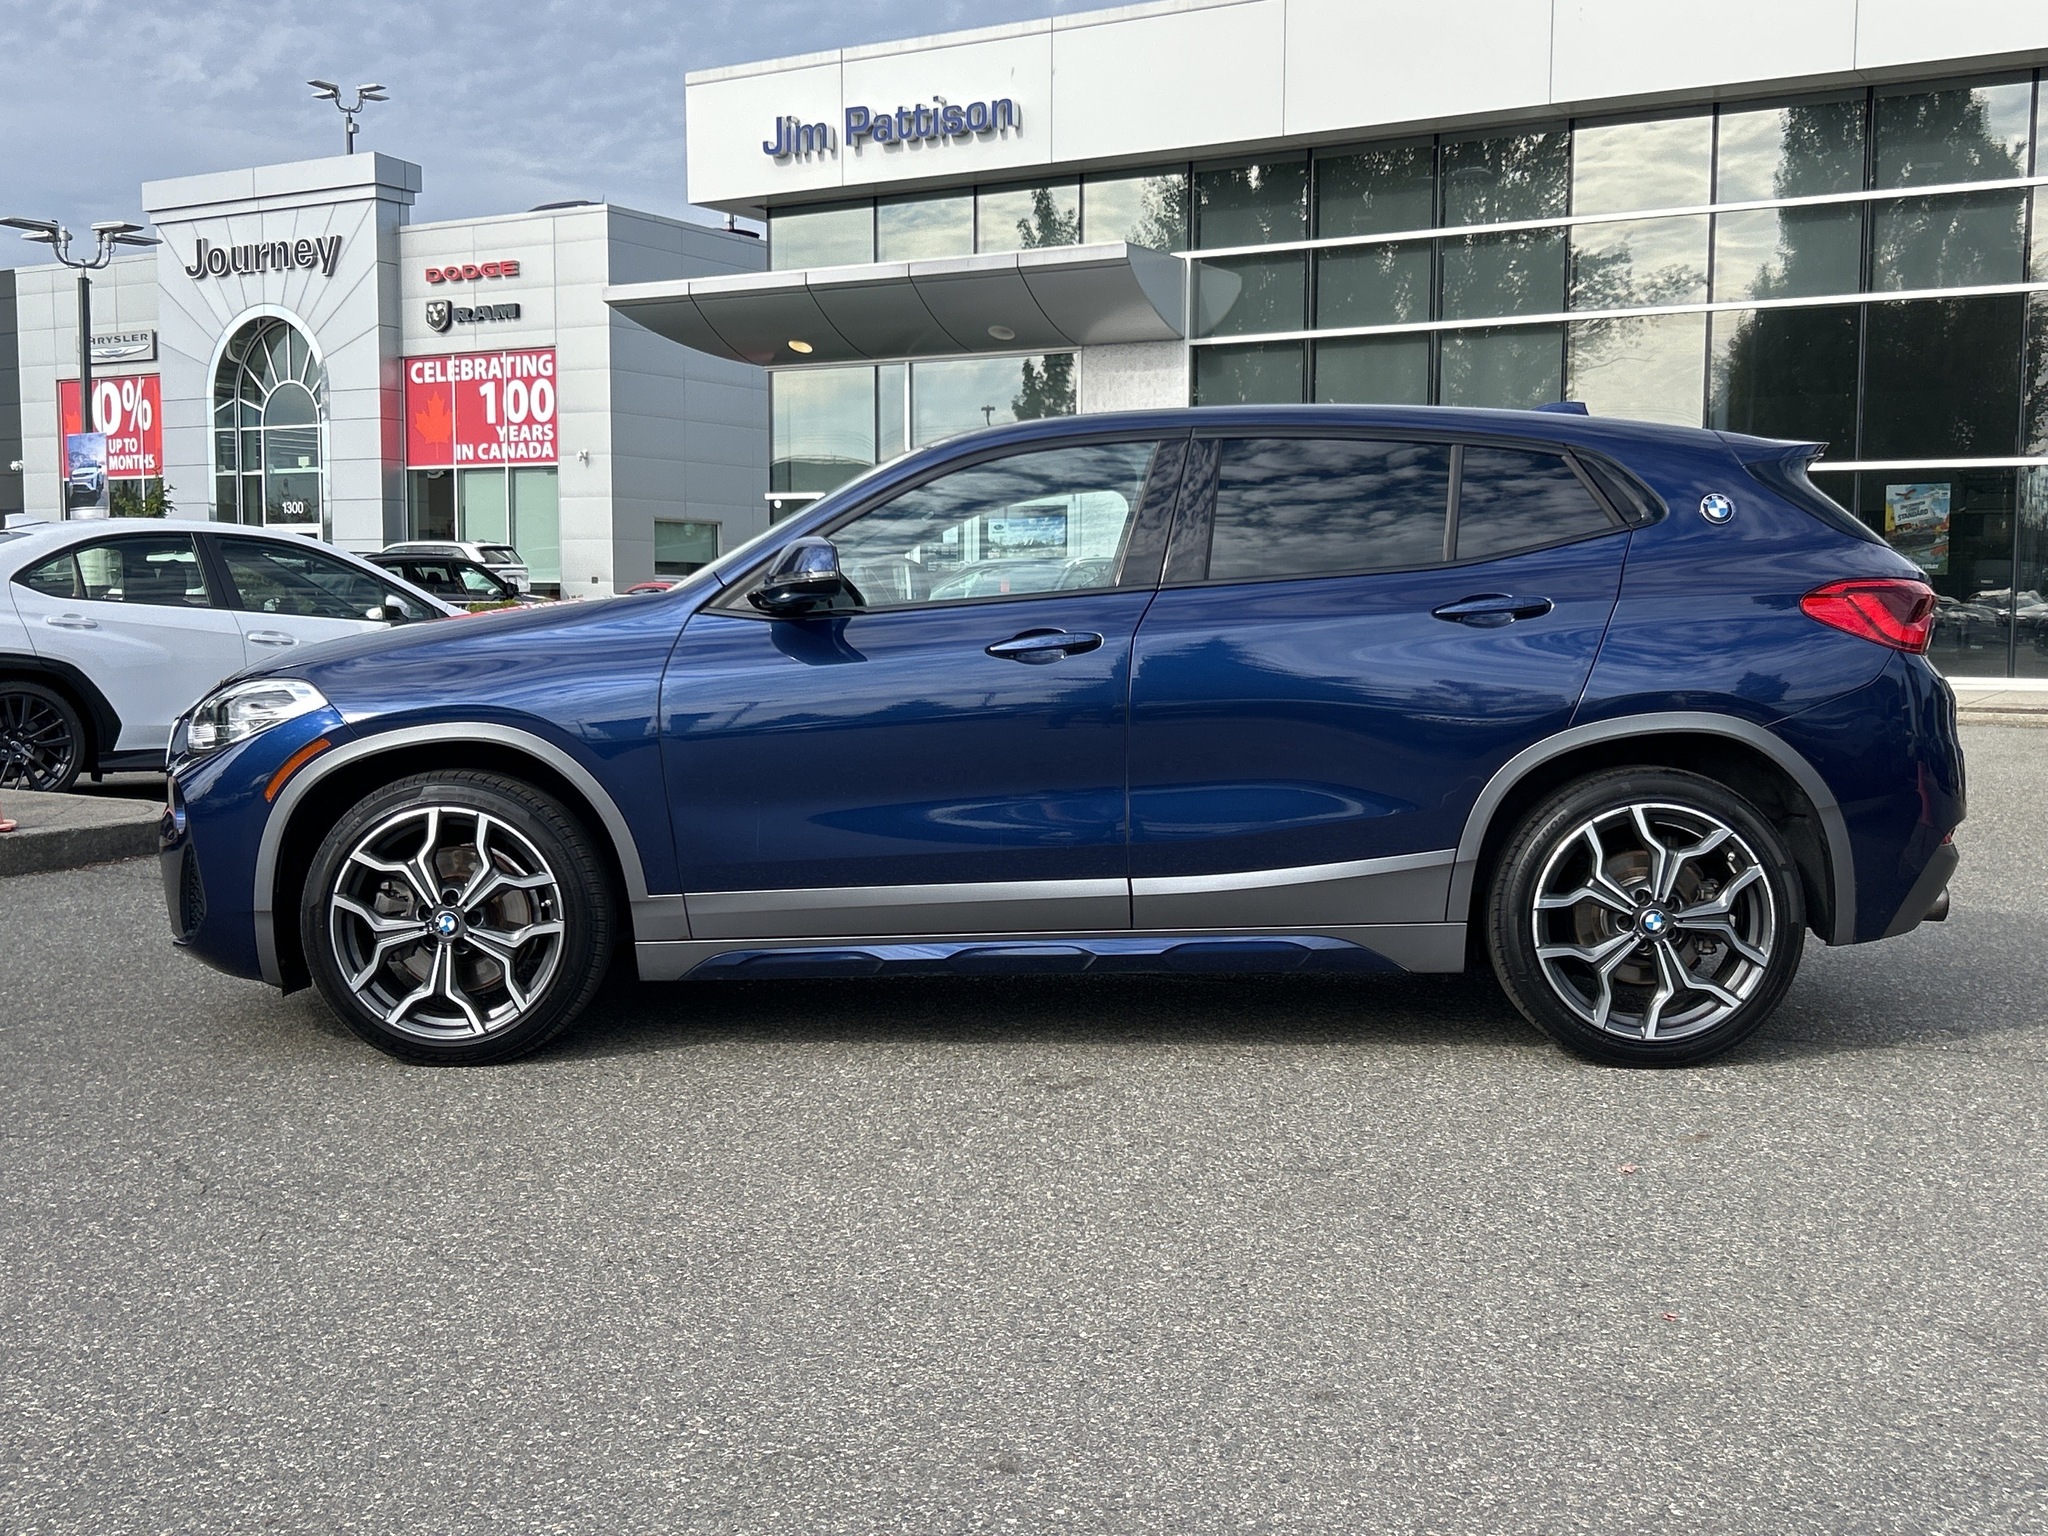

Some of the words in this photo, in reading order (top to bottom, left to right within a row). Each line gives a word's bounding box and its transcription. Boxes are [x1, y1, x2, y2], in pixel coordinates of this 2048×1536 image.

[763, 115, 834, 156] Jim
[845, 95, 1019, 148] Pattison
[185, 234, 342, 279] Journey
[425, 260, 520, 284] DODGE
[453, 303, 520, 323] RAM
[89, 333, 148, 345] HRYSLER
[410, 353, 554, 385] CELEBRATING
[479, 378, 555, 425] 100
[495, 424, 554, 442] YEARS
[108, 439, 122, 453] UP
[124, 437, 138, 453] TO
[456, 443, 474, 461] IN
[477, 441, 555, 461] CANADA
[108, 453, 154, 470] MONTHS
[282, 501, 304, 514] 1300
